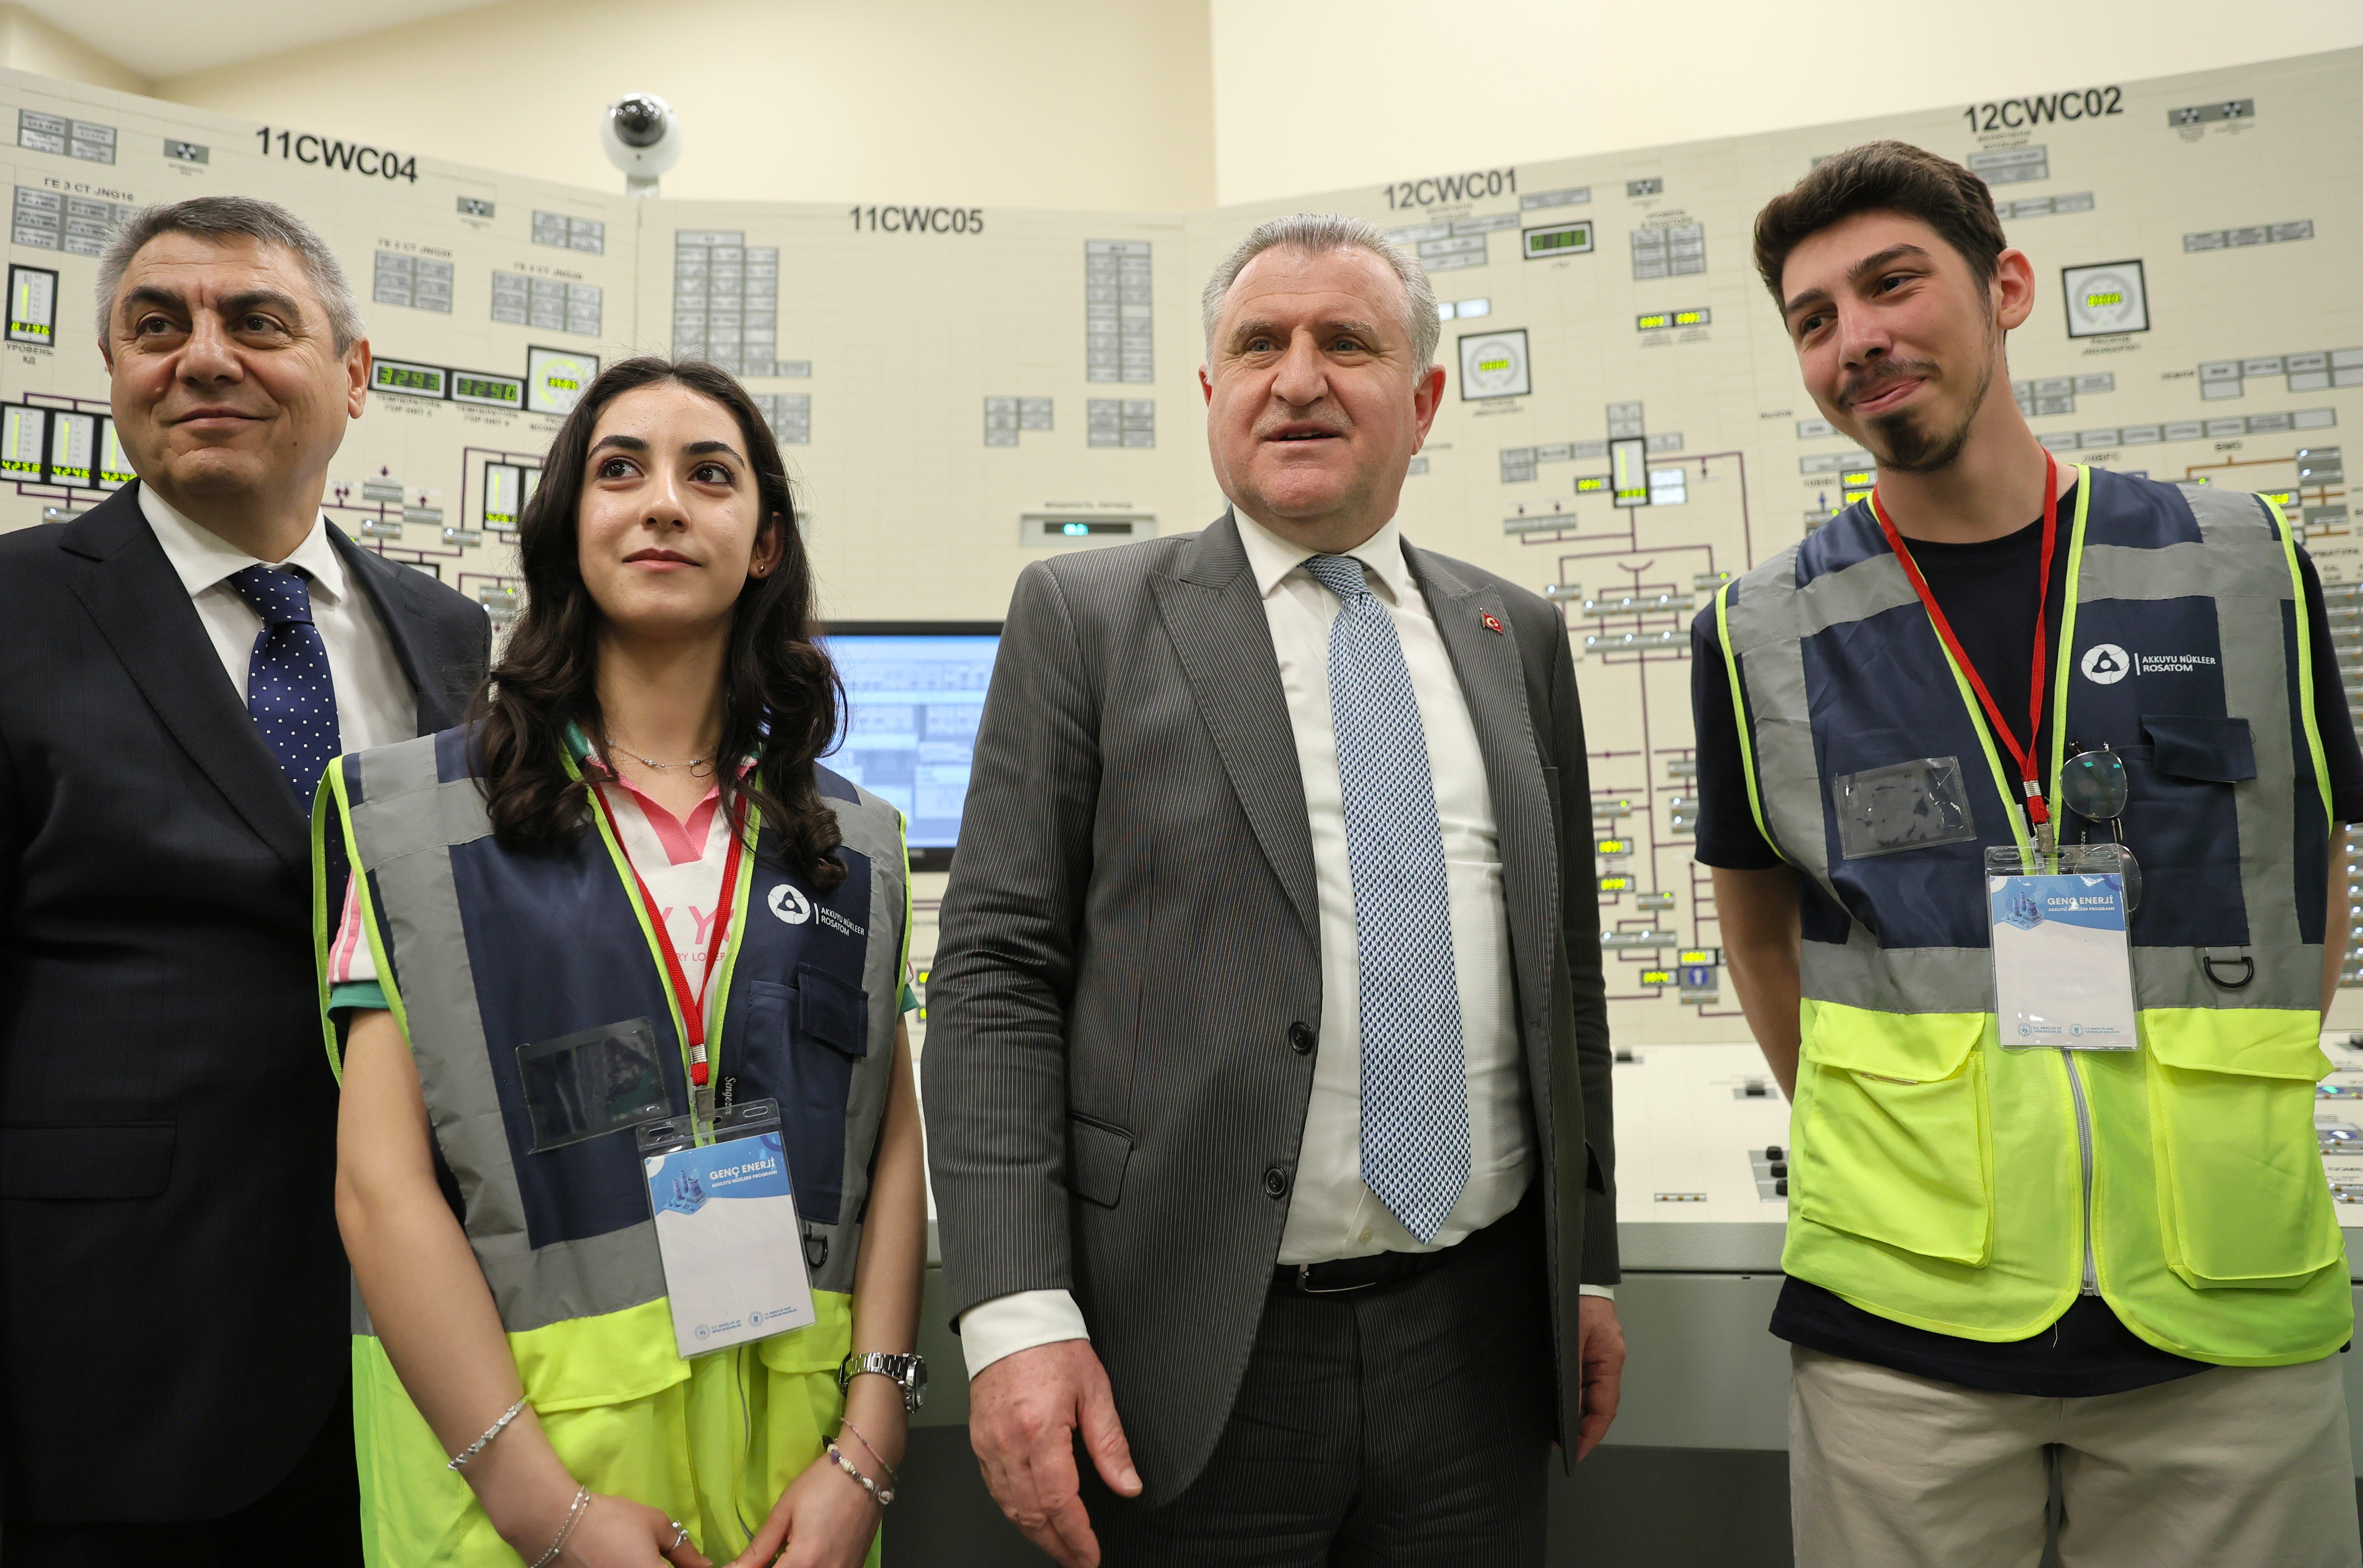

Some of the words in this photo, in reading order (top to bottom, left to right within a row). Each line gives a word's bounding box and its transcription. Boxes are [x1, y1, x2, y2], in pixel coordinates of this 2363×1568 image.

[1963, 86, 2123, 133] 12CWC02
[256, 126, 418, 183] 11CWC04
[1383, 167, 1517, 210] 12CWC01
[849, 206, 983, 234] 11CWC05
[378, 366, 440, 391] 3293
[458, 378, 517, 401] 3290
[2179, 654, 2216, 665] NÜKLEER
[2079, 894, 2114, 904] ENERJİ
[821, 907, 843, 923] AKKUYU
[844, 917, 864, 936] NÜKLEER
[821, 915, 849, 937] ROSATOM
[709, 1166, 740, 1180] GENÇ
[741, 1156, 776, 1173] ENERJİ
[711, 1180, 731, 1188] AKKUYU
[752, 1169, 778, 1179] PROGRAMI
